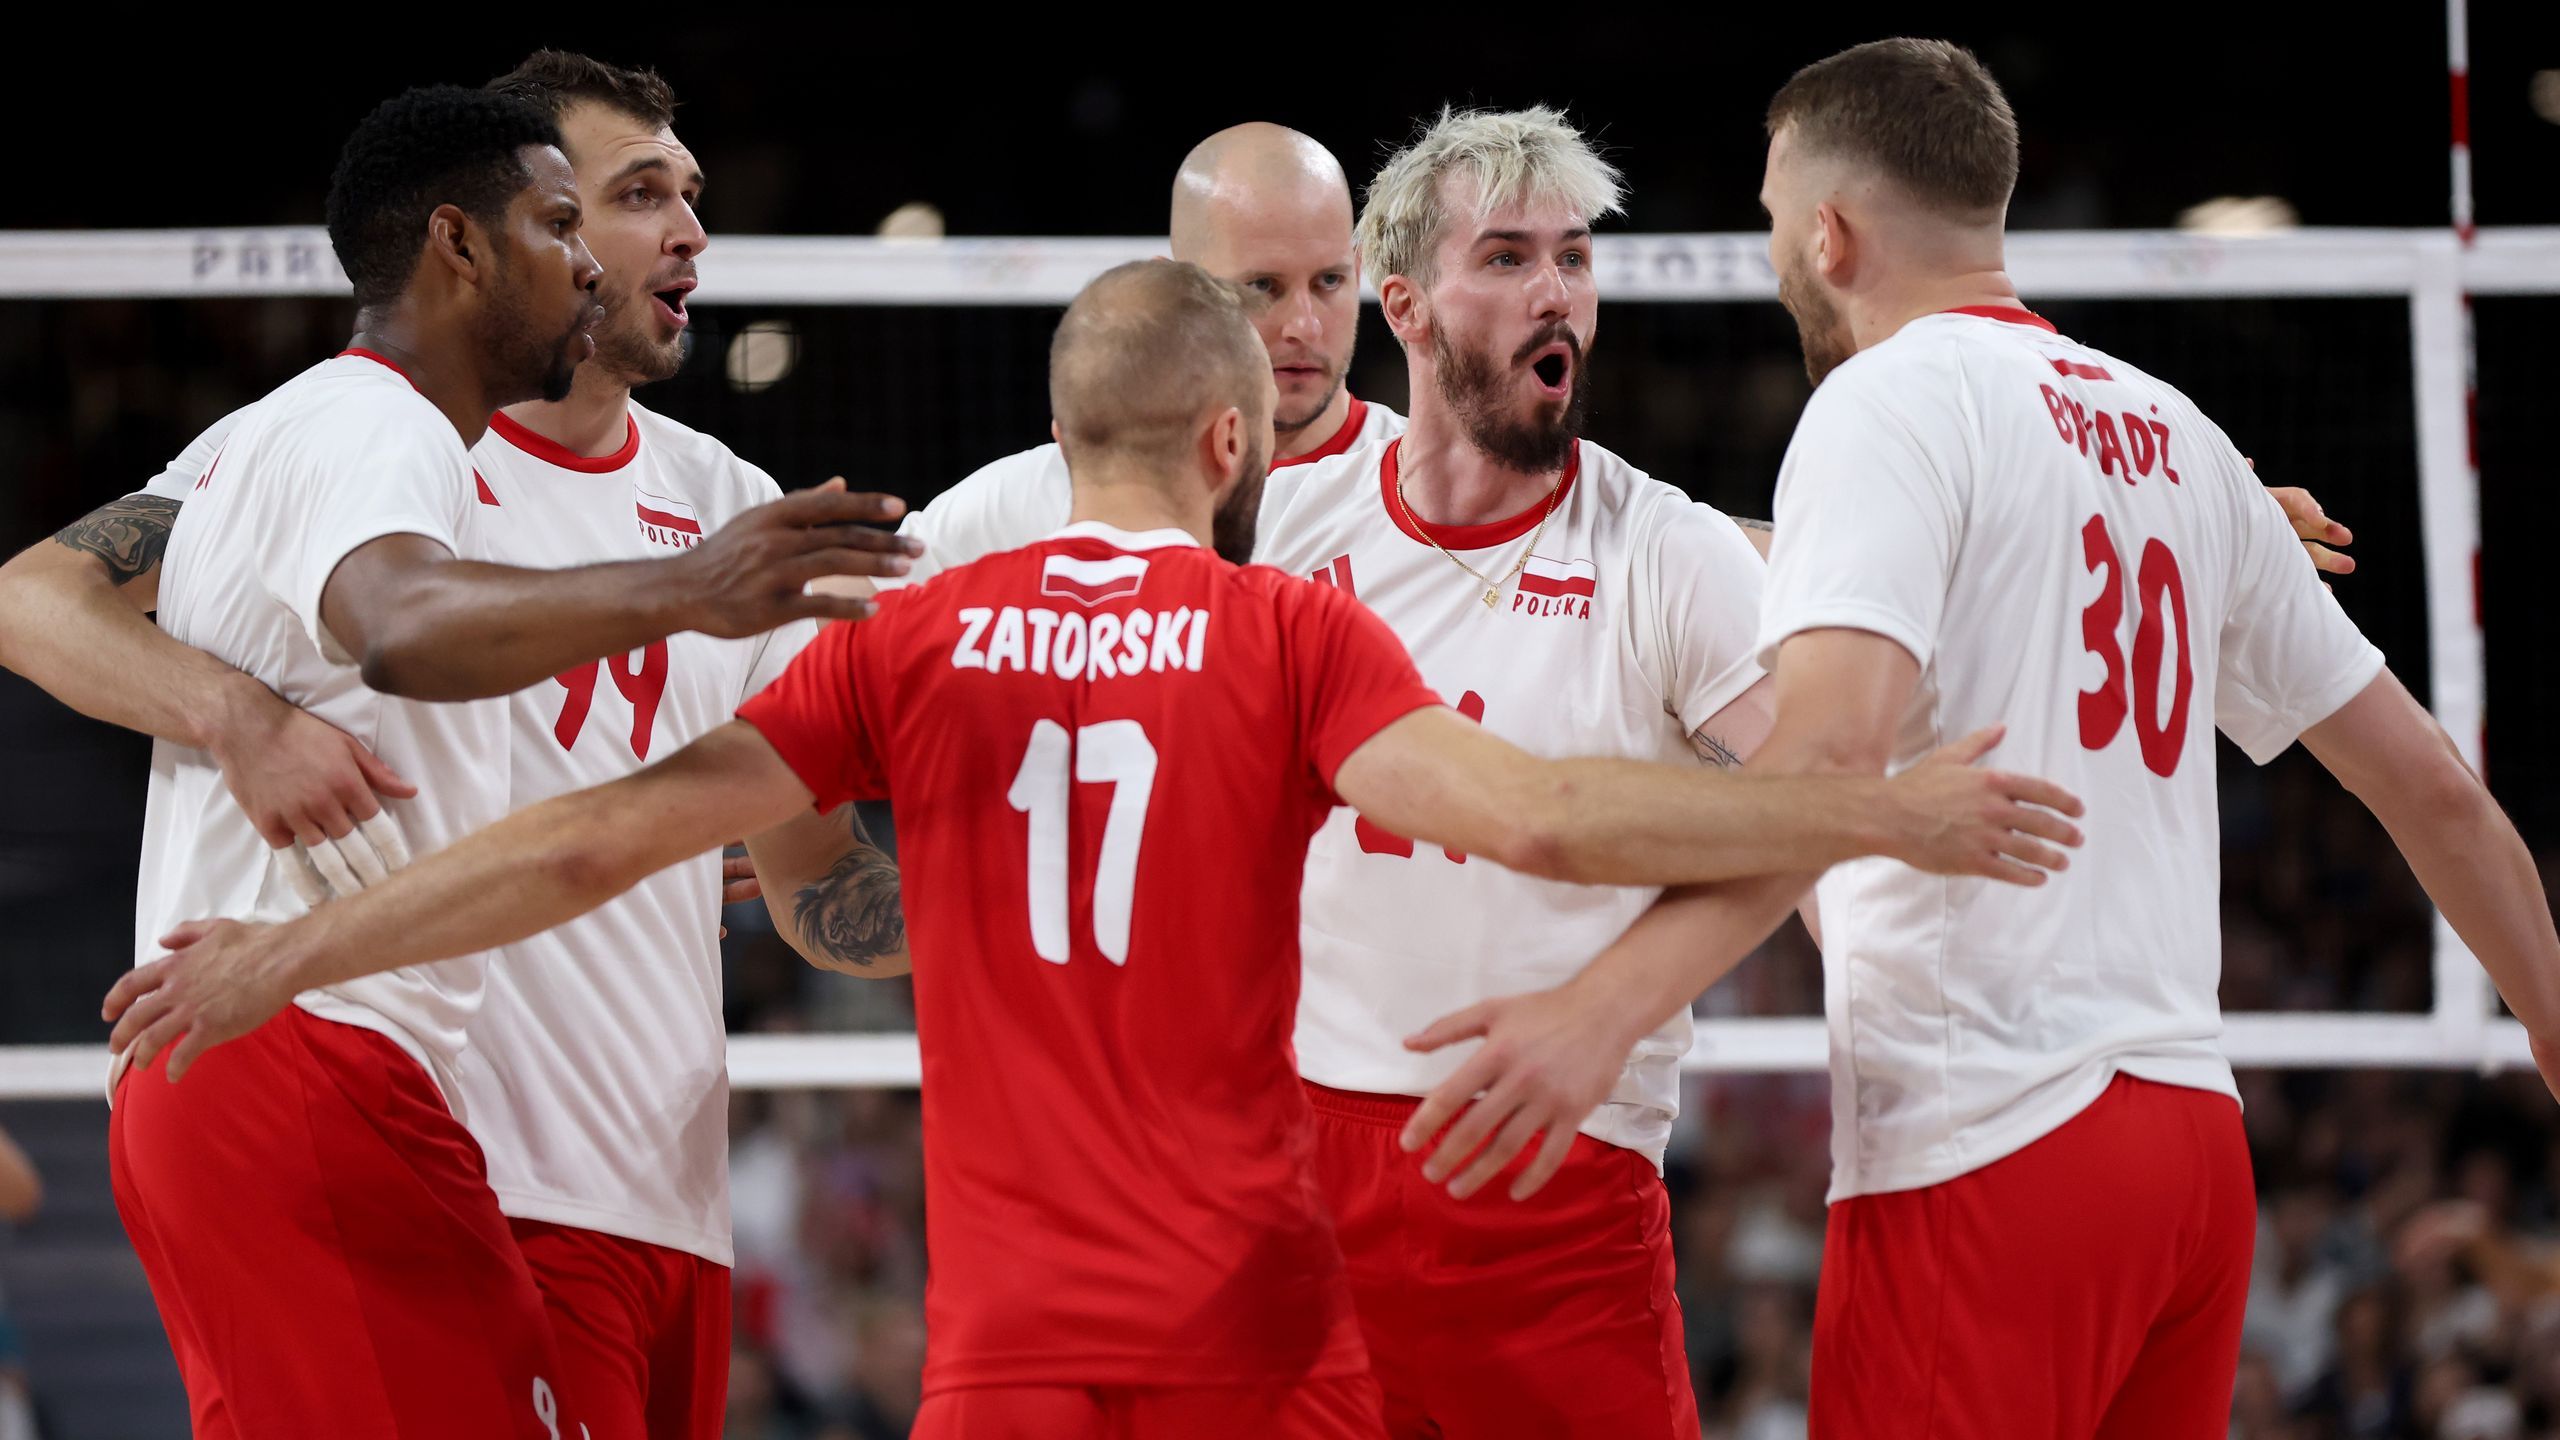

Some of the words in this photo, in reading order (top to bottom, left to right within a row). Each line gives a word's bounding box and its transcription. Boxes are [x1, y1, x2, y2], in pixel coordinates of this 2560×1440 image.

[951, 606, 1209, 681] ZATORSKI
[1512, 593, 1590, 620] POLSKA
[2078, 513, 2193, 778] 30
[1008, 718, 1157, 966] 17
